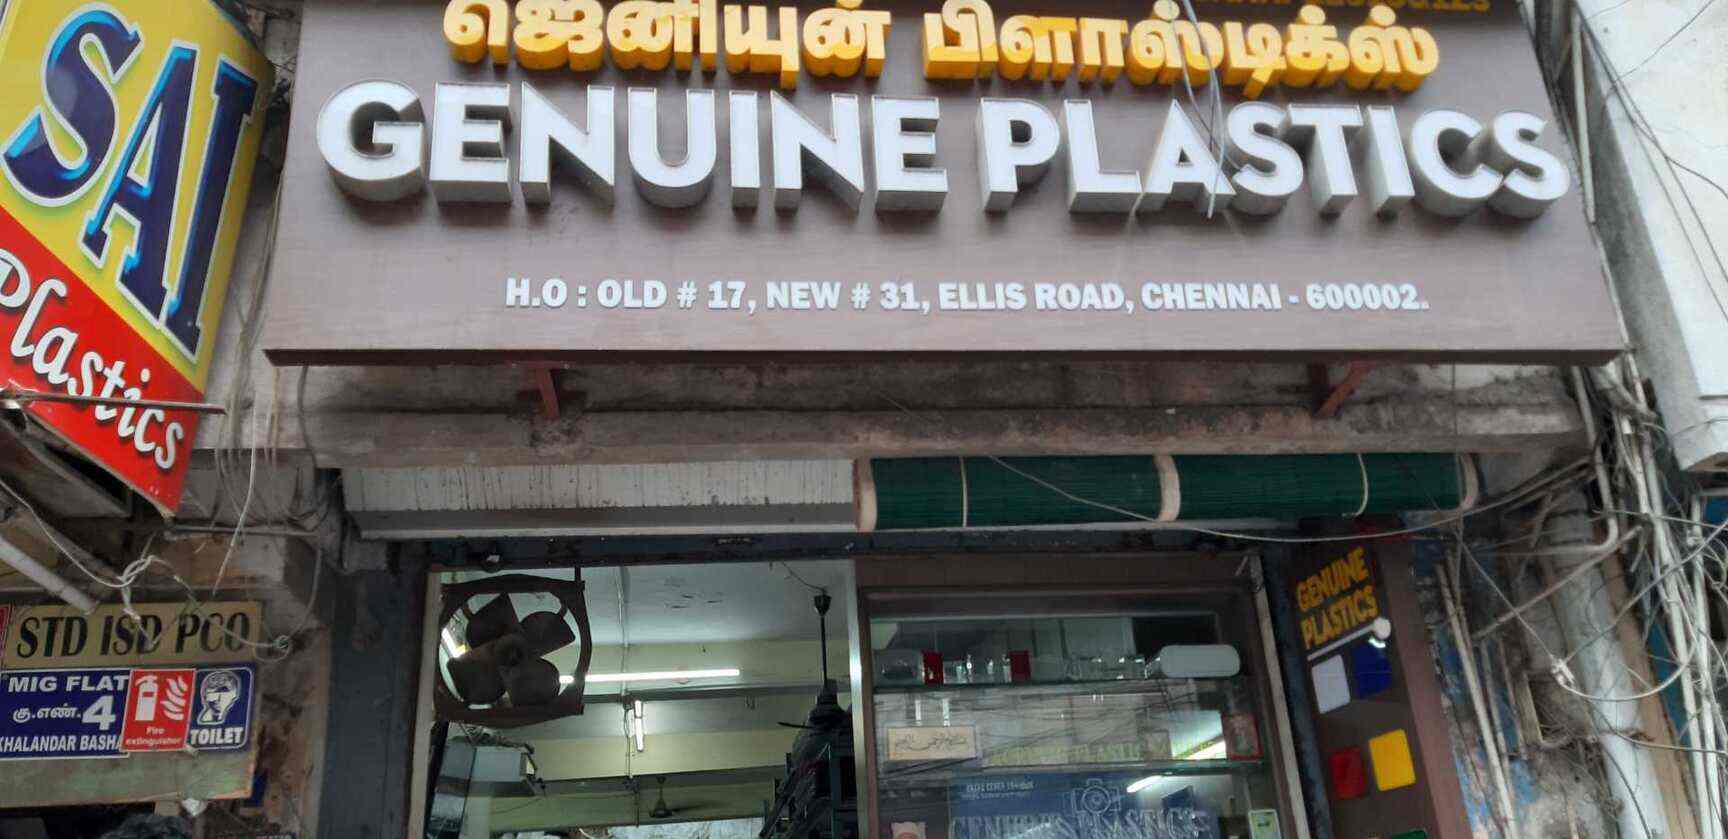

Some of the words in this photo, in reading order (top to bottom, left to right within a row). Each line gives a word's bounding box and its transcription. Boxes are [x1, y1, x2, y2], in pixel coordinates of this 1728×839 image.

[317, 80, 949, 208] GENUINE
[978, 97, 1571, 218] PLASTICS
[0, 2, 258, 363] SAI
[505, 277, 568, 308] H.O
[596, 279, 668, 309] OLD
[676, 281, 698, 309] #
[707, 281, 758, 314] 17,
[766, 281, 842, 310] NEW
[850, 282, 872, 310] #
[879, 282, 930, 316] 31,
[938, 282, 1027, 311] ELLIS
[1035, 282, 1135, 315] ROAD,
[1141, 282, 1283, 311] CHENNAI
[1305, 283, 1431, 312] 600002.
[1296, 546, 1370, 612] GENUINE
[16, 614, 90, 659] STD
[100, 613, 163, 656] ISD
[175, 611, 251, 654] PCO
[1301, 585, 1378, 650] PLASTICS
[8, 675, 58, 693] MIG
[66, 674, 129, 692] FLAT
[125, 736, 183, 748] extinguisher
[145, 725, 165, 736] Fire
[190, 726, 244, 745] TOILET
